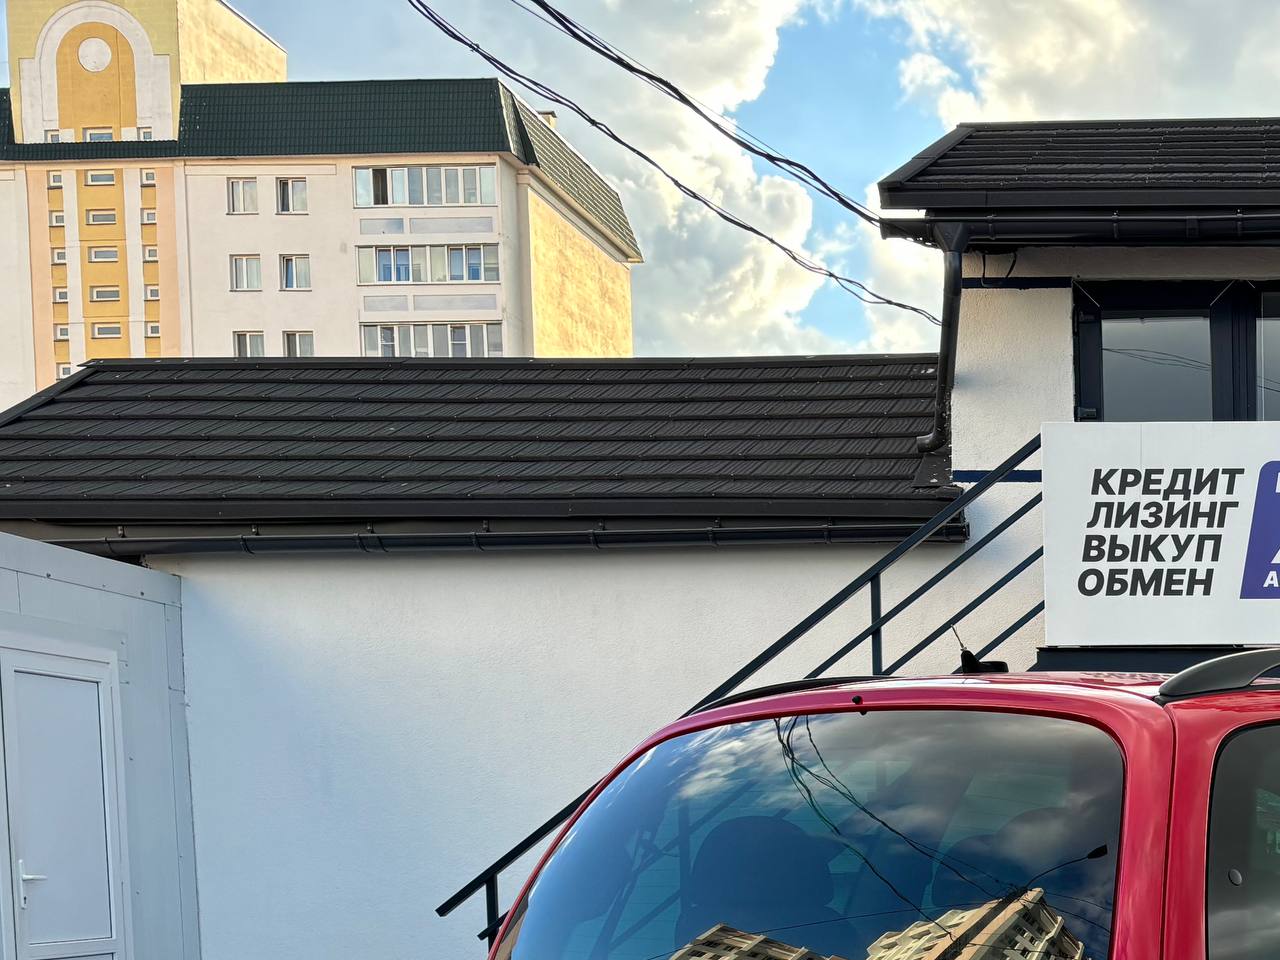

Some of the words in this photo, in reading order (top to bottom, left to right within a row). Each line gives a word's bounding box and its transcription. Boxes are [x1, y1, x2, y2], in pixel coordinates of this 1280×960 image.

[1090, 467, 1245, 501] КРЕДИТ
[1086, 501, 1240, 529] ЛИЗИНГ
[1081, 534, 1223, 563] ВЫКУП
[1077, 568, 1215, 597] ОБМЕН
